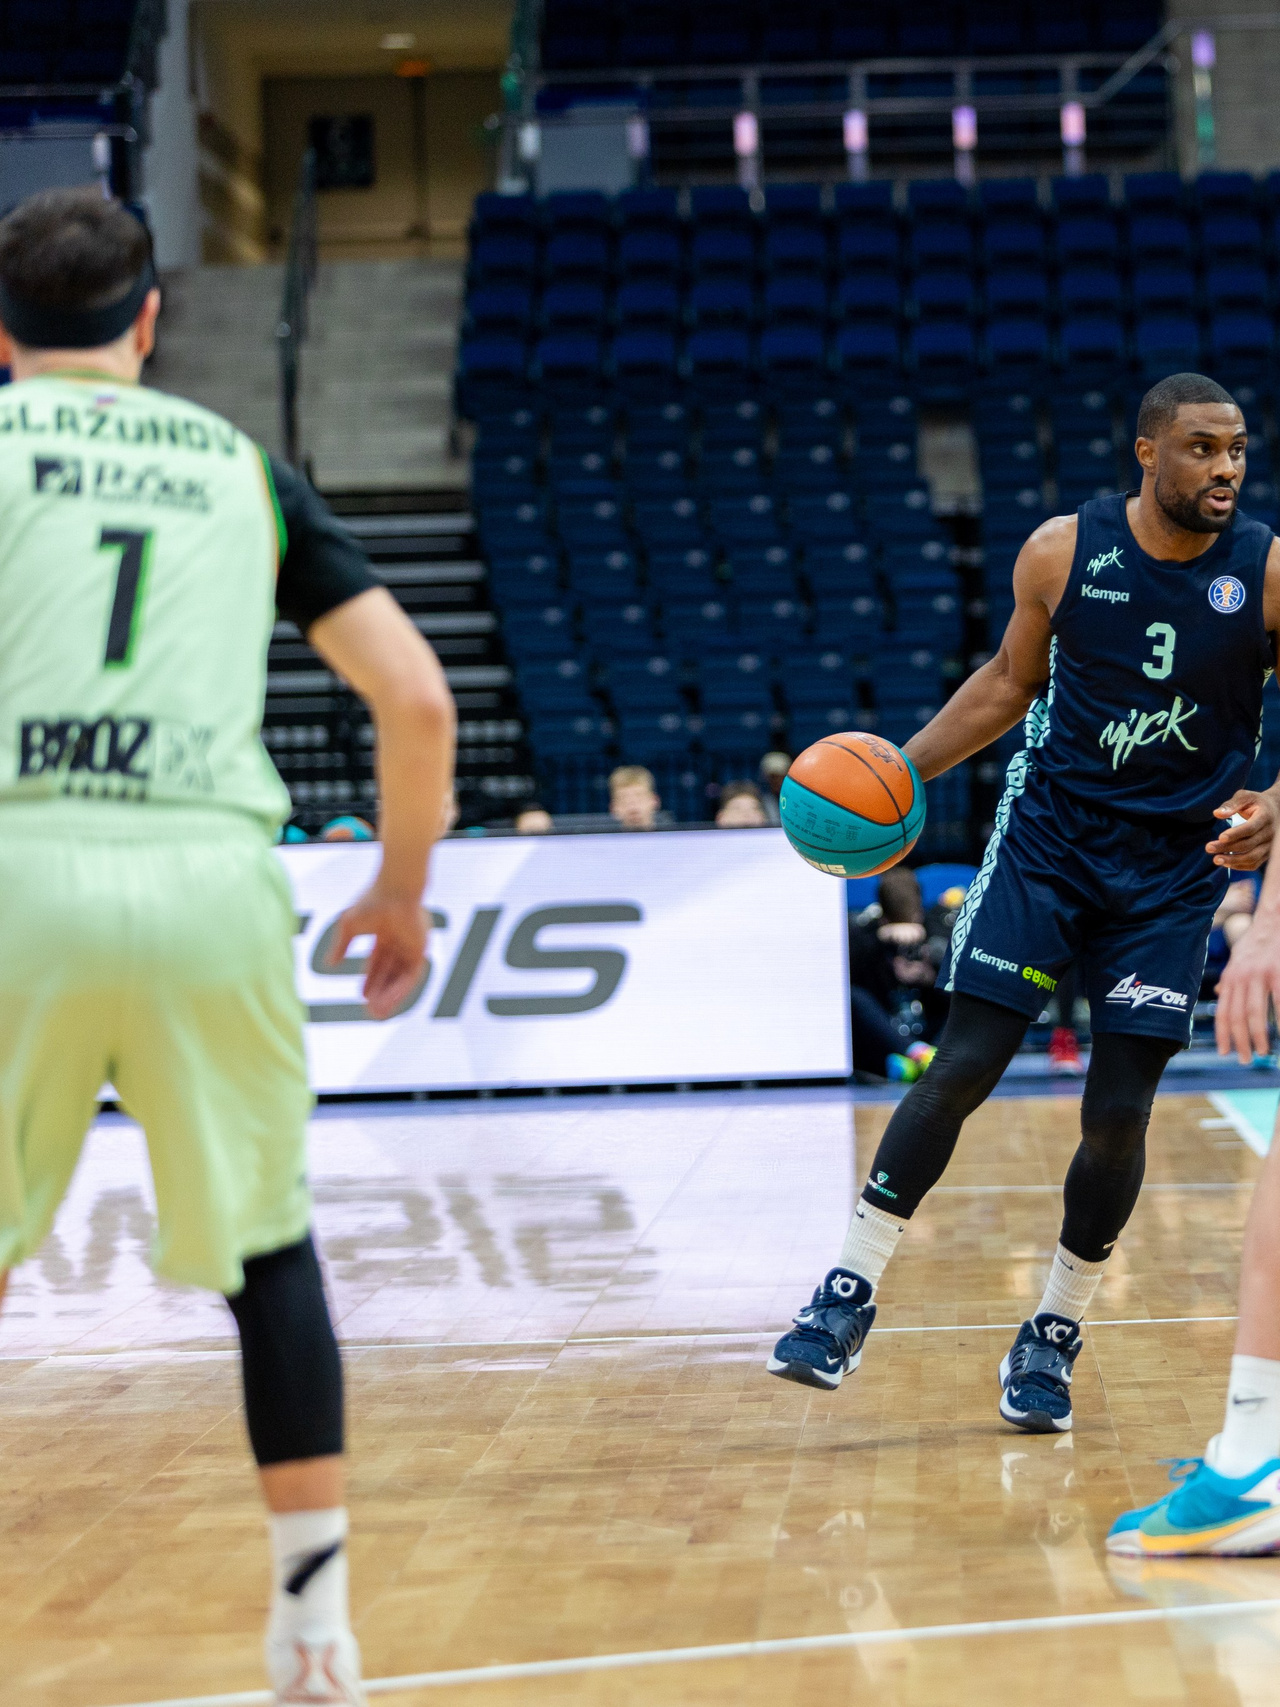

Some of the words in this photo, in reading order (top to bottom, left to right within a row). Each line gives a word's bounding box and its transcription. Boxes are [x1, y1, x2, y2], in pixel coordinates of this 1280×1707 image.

[1081, 584, 1130, 604] Kempa
[1142, 621, 1176, 680] 3
[969, 946, 1019, 973] Kempa
